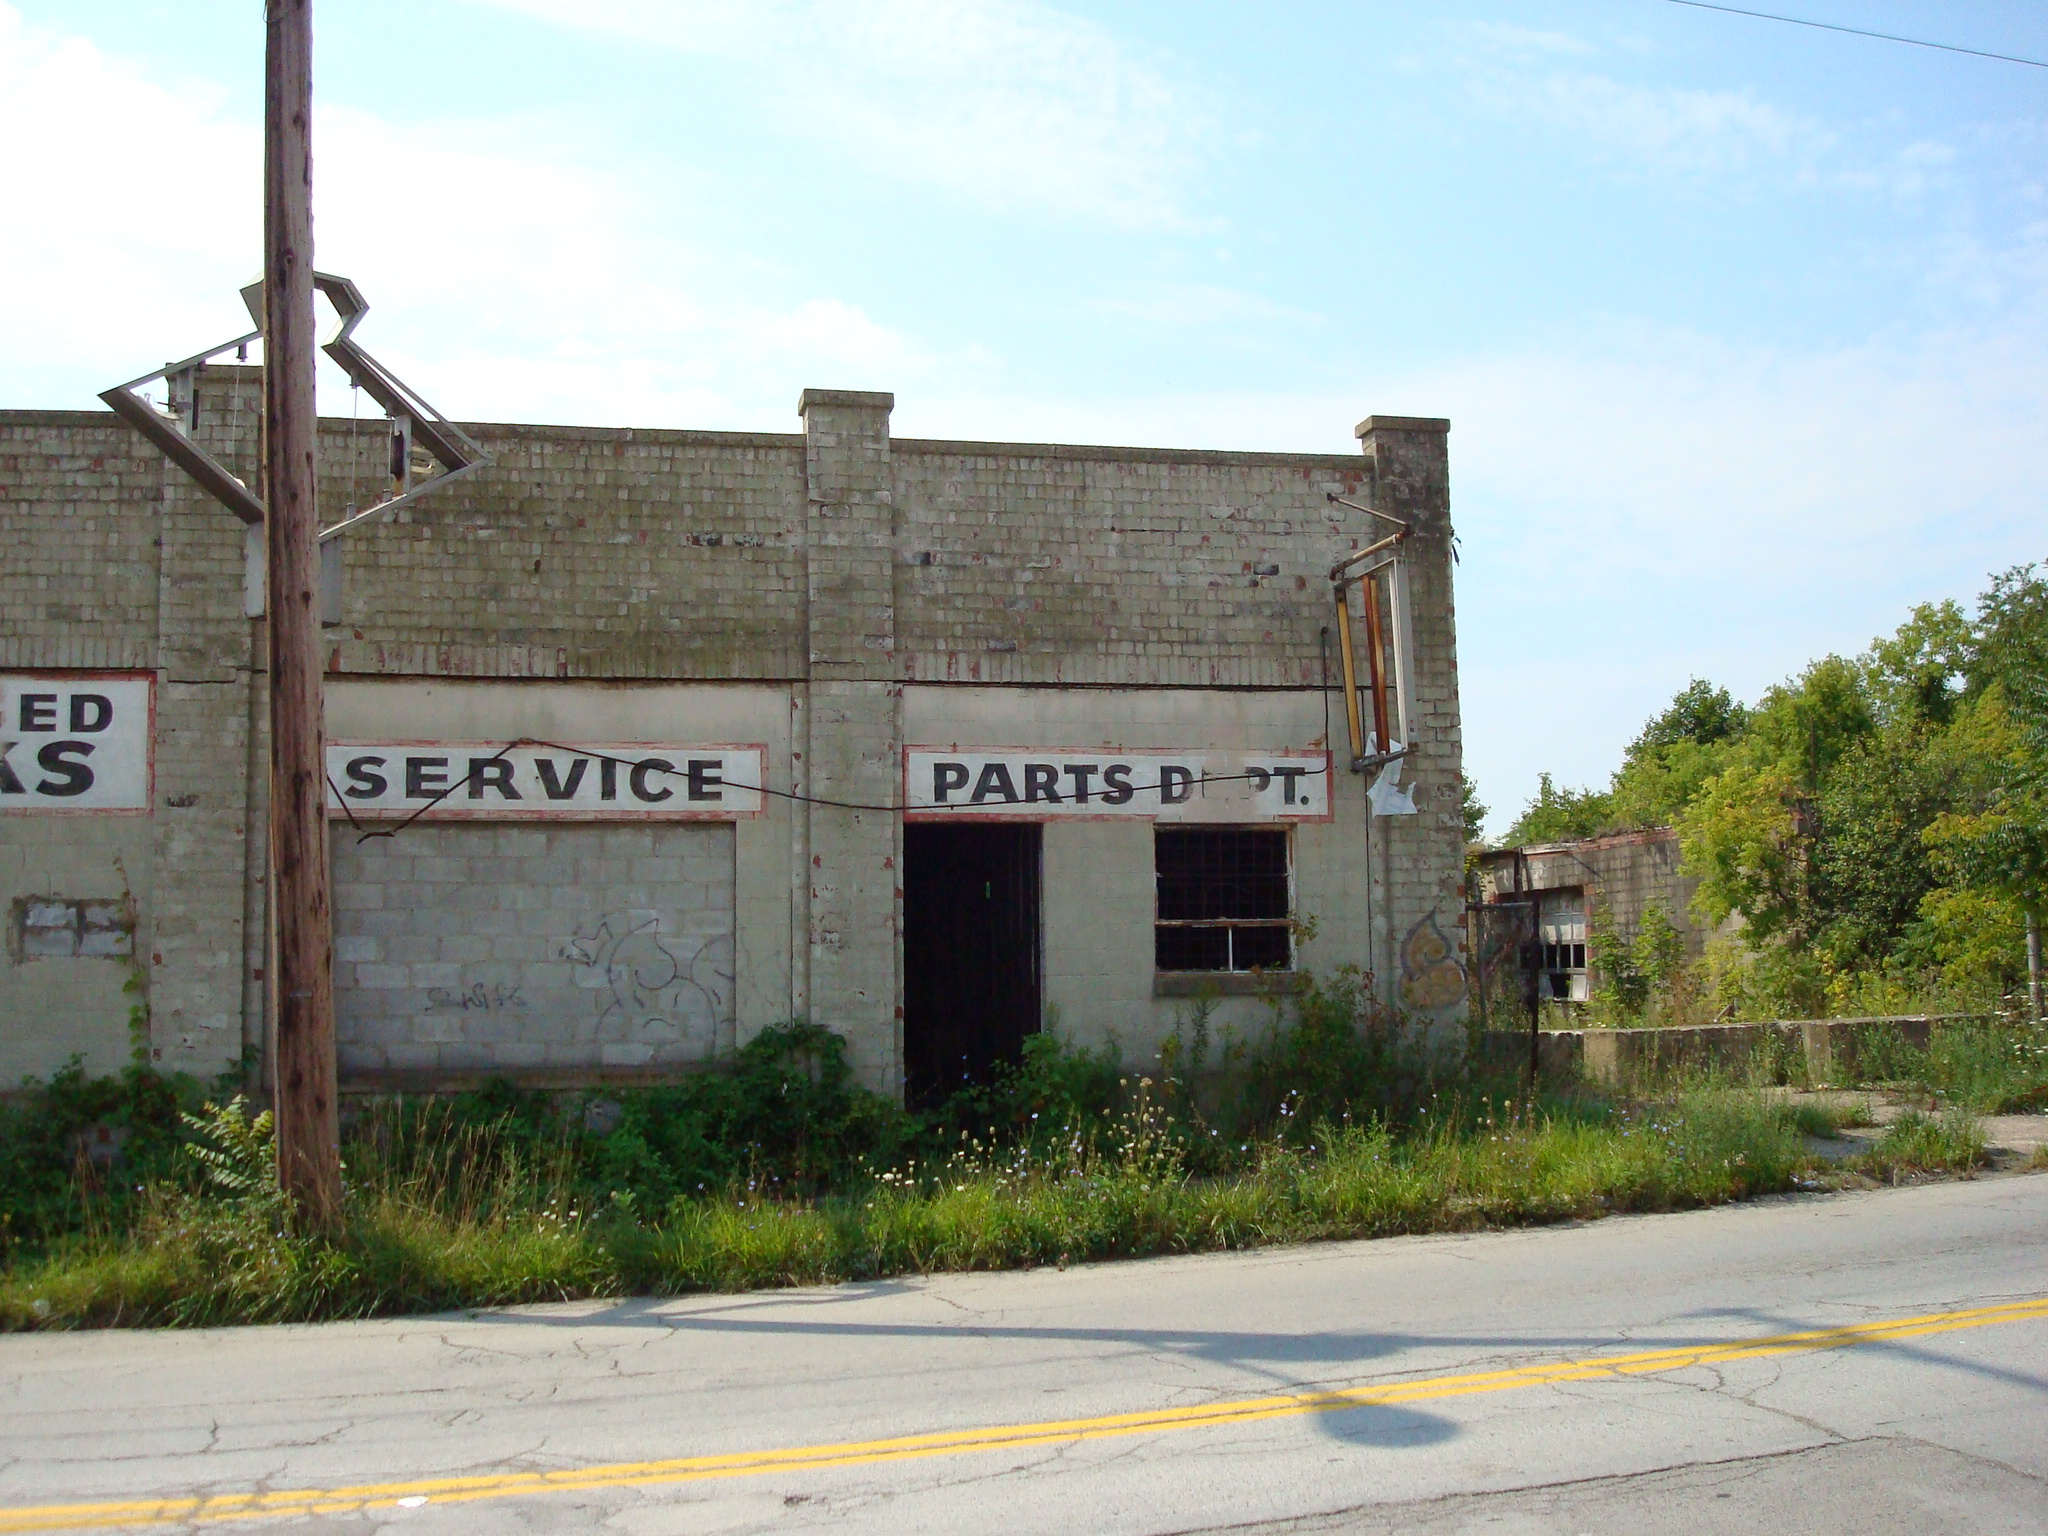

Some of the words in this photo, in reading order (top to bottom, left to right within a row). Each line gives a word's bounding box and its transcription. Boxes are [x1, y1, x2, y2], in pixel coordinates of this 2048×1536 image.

[0, 694, 114, 733] ED
[344, 755, 724, 803] SERVICE
[933, 762, 1134, 806] PARTS
[1160, 765, 1310, 806] DPT.
